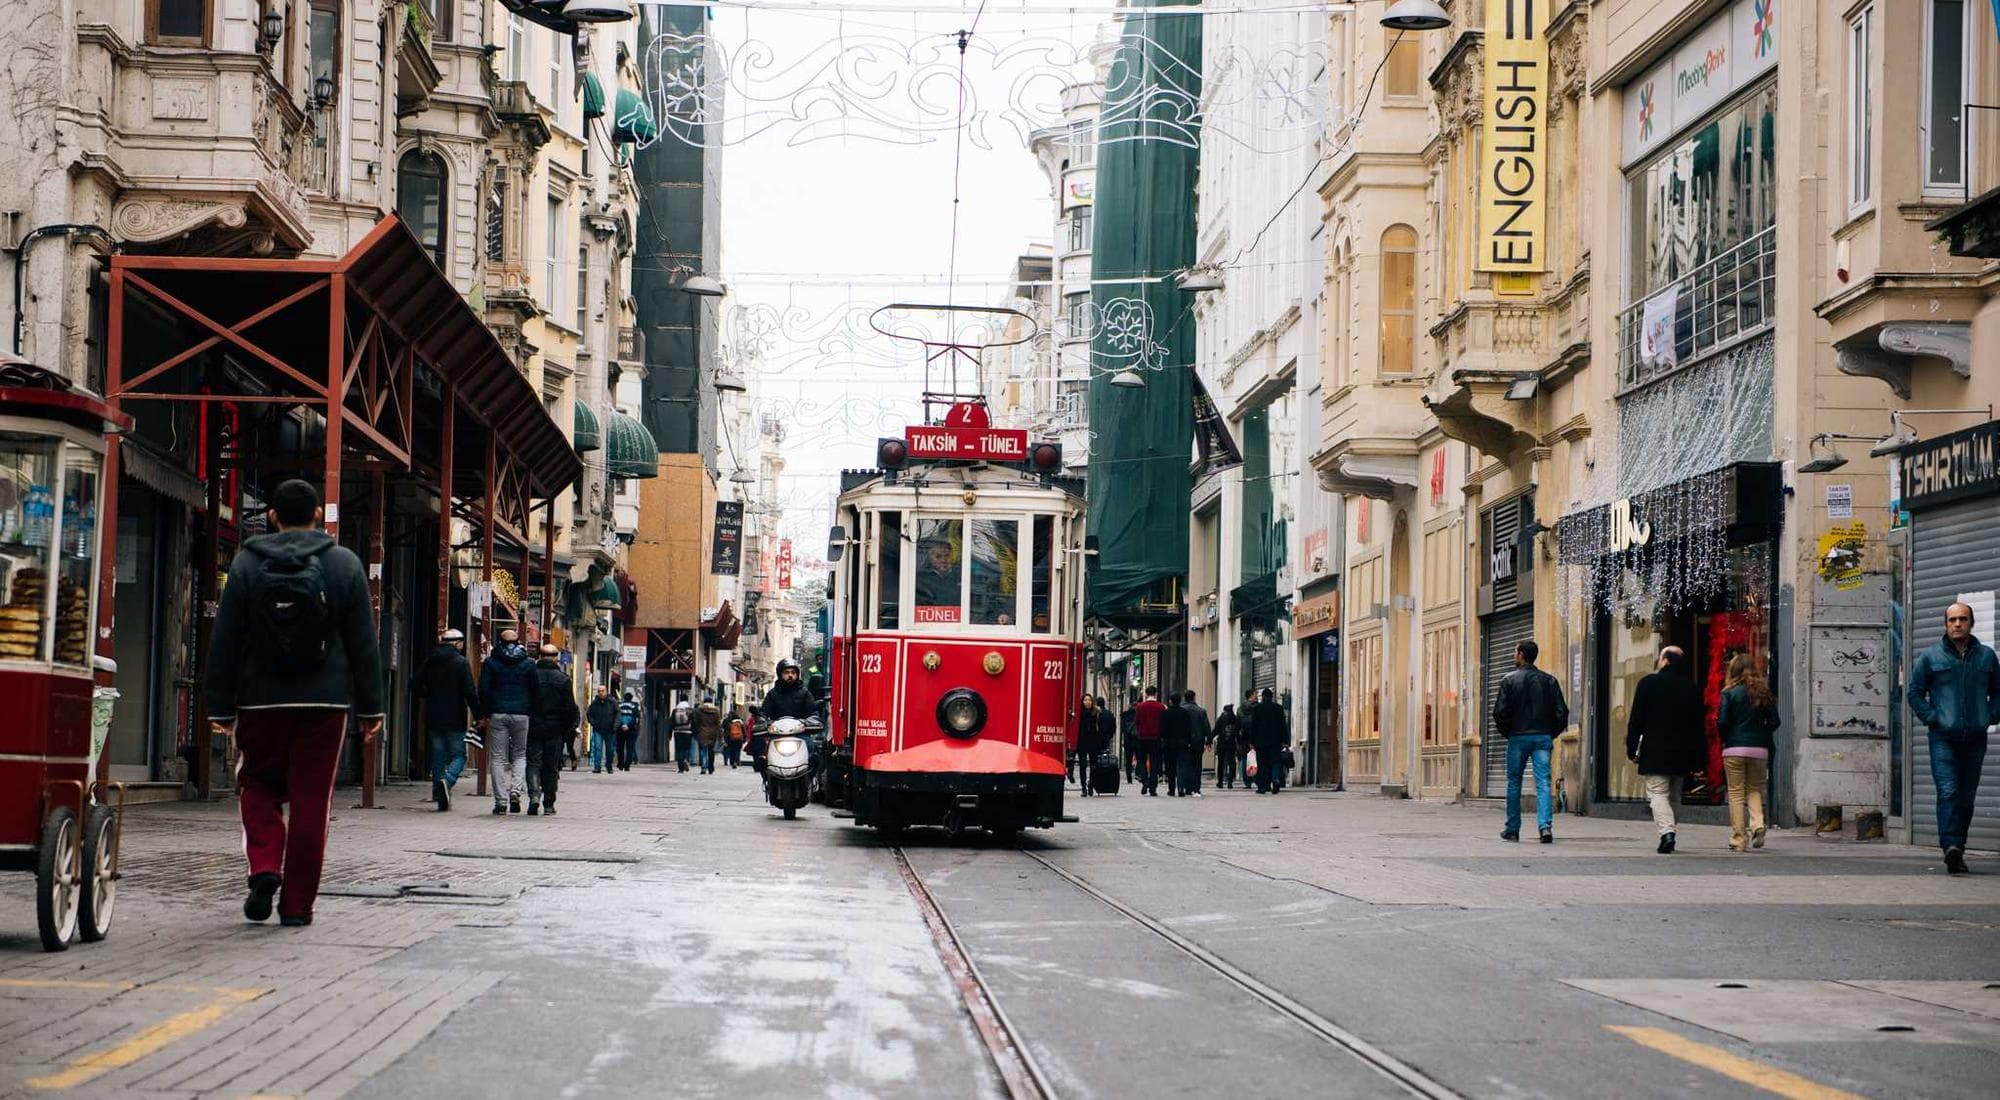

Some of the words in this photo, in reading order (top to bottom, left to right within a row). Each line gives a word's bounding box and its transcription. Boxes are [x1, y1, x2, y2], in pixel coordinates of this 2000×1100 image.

[1492, 61, 1537, 264] ENGLISH
[962, 404, 972, 423] 2
[912, 432, 957, 452] TAKSİM
[980, 434, 1022, 454] TÜNEL
[917, 607, 958, 621] TÜNEL
[862, 653, 882, 673] 223
[1044, 660, 1062, 680] 223
